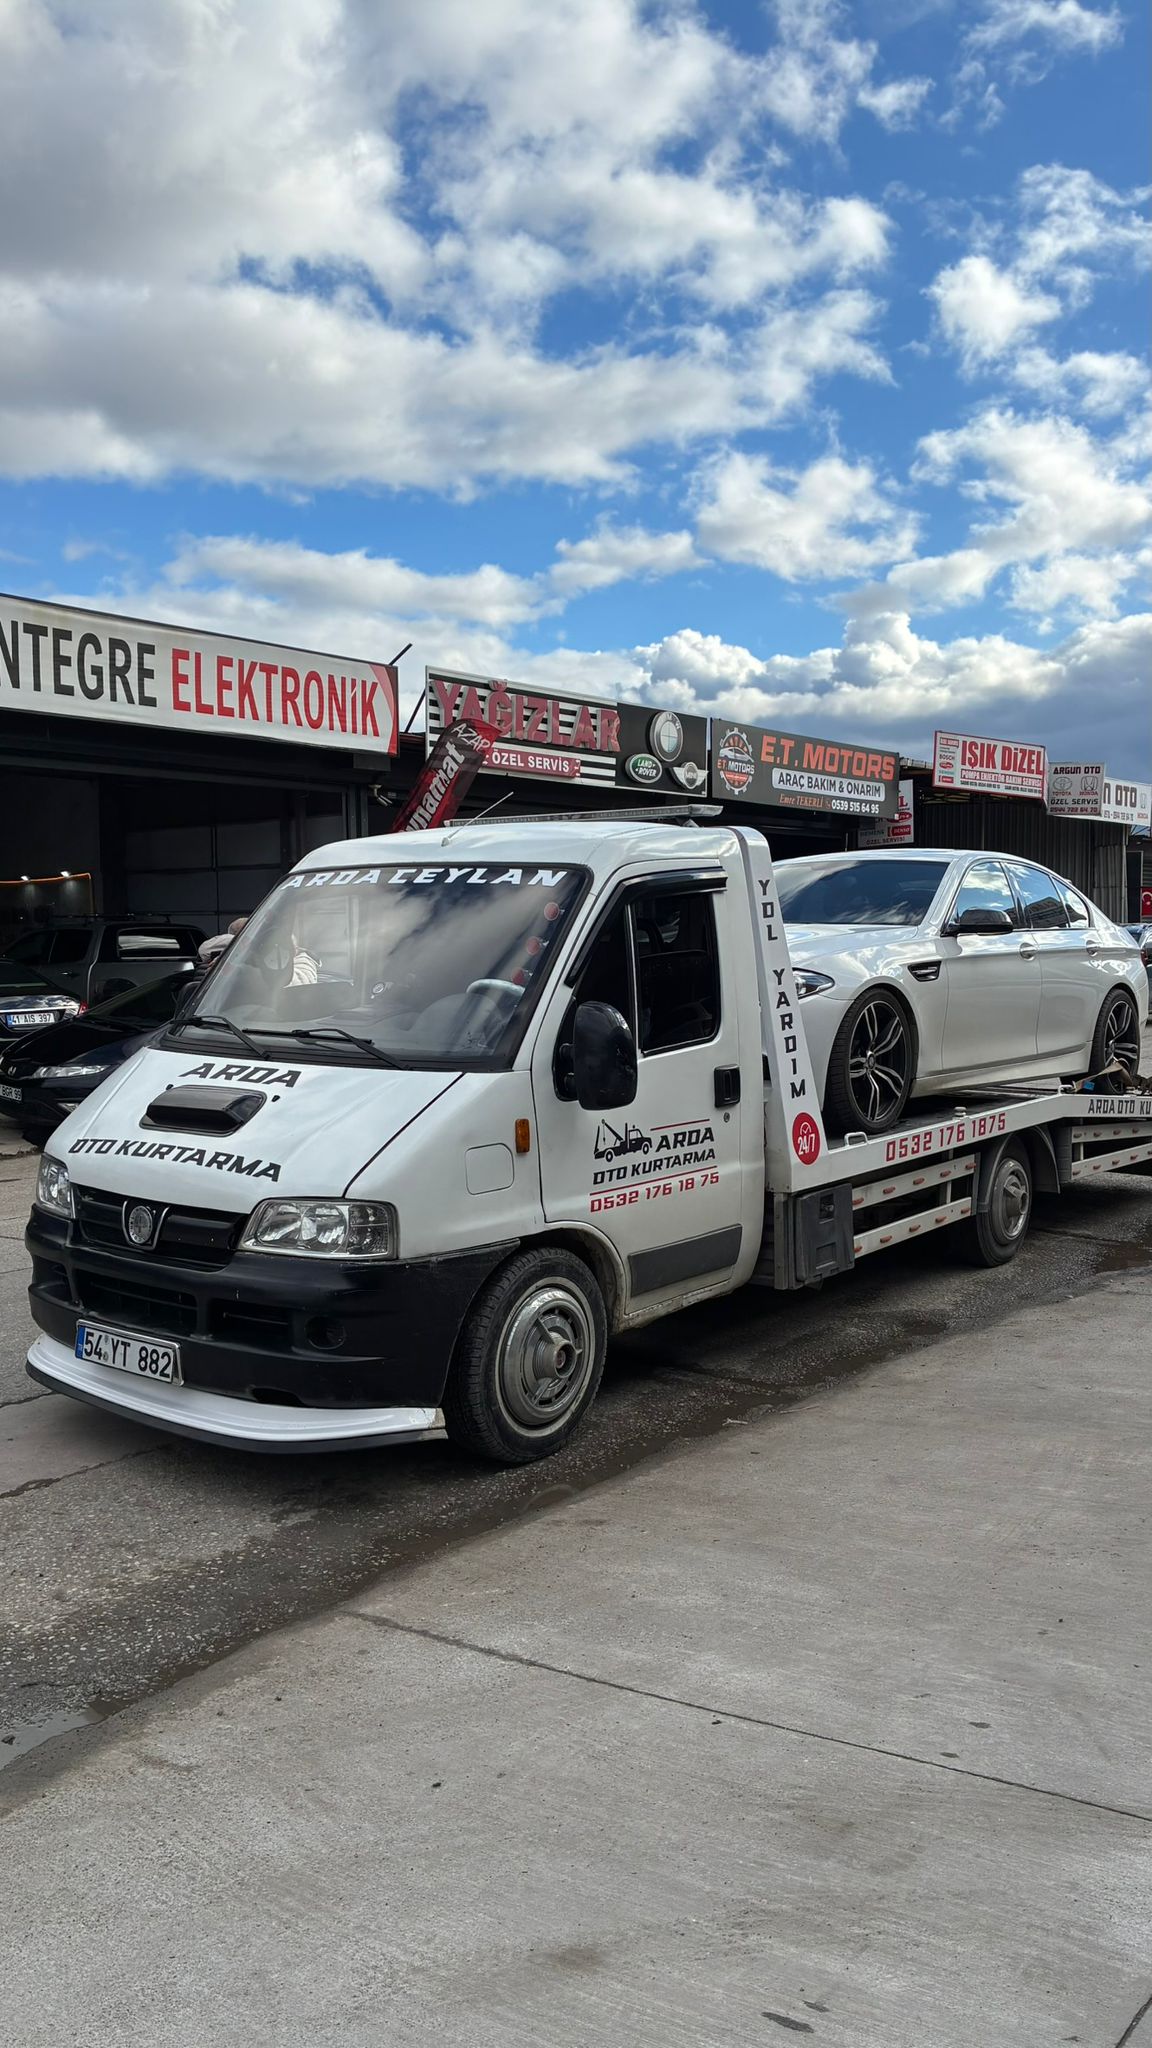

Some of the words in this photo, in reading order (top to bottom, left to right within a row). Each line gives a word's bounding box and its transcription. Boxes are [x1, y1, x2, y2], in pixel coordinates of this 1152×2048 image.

[430, 679, 621, 752] YAĞIZLAR
[451, 723, 491, 752] AZAP
[491, 749, 525, 767] ÖZEL
[527, 755, 570, 773] SERVİS
[637, 759, 653, 768] LAND
[802, 743, 896, 780] MOTORS
[961, 740, 998, 769] IŞIK
[637, 767, 657, 777] ROVER
[1053, 766, 1081, 775] ARGUN
[1084, 766, 1101, 775] OTO
[778, 771, 805, 789] ARAÇ
[807, 776, 837, 793] BAKIM
[838, 781, 845, 794] &
[846, 782, 881, 798] ONARIM
[1115, 784, 1138, 808] OTO
[831, 799, 849, 812] 0539
[849, 801, 861, 813] 515
[861, 803, 870, 814] 64
[871, 804, 880, 815] 95
[1050, 796, 1069, 806] ÖZEL
[281, 869, 379, 891] ARDA
[387, 867, 569, 888] CEYLAN
[38, 1013, 51, 1023] 397
[772, 967, 807, 1100] YARDIM
[178, 1062, 302, 1088] ARDA
[1087, 1098, 1116, 1115] ARDA
[1117, 1099, 1136, 1115] OTO
[655, 1127, 715, 1153] ARDA
[797, 1133, 816, 1156] 24/7
[885, 1130, 933, 1162] 0532
[940, 1122, 965, 1148] 176
[972, 1112, 1006, 1138] 1875
[68, 1138, 119, 1154] OTO
[114, 1139, 282, 1183] KURTARMA
[592, 1165, 628, 1186] OTO
[630, 1148, 716, 1177] KURTARMA
[590, 1190, 640, 1213] 0532
[645, 1182, 673, 1200] 176
[678, 1177, 695, 1192] 18
[700, 1171, 720, 1187] 75
[83, 1331, 103, 1361] 54
[111, 1337, 131, 1368] YT
[137, 1345, 172, 1379] 882
